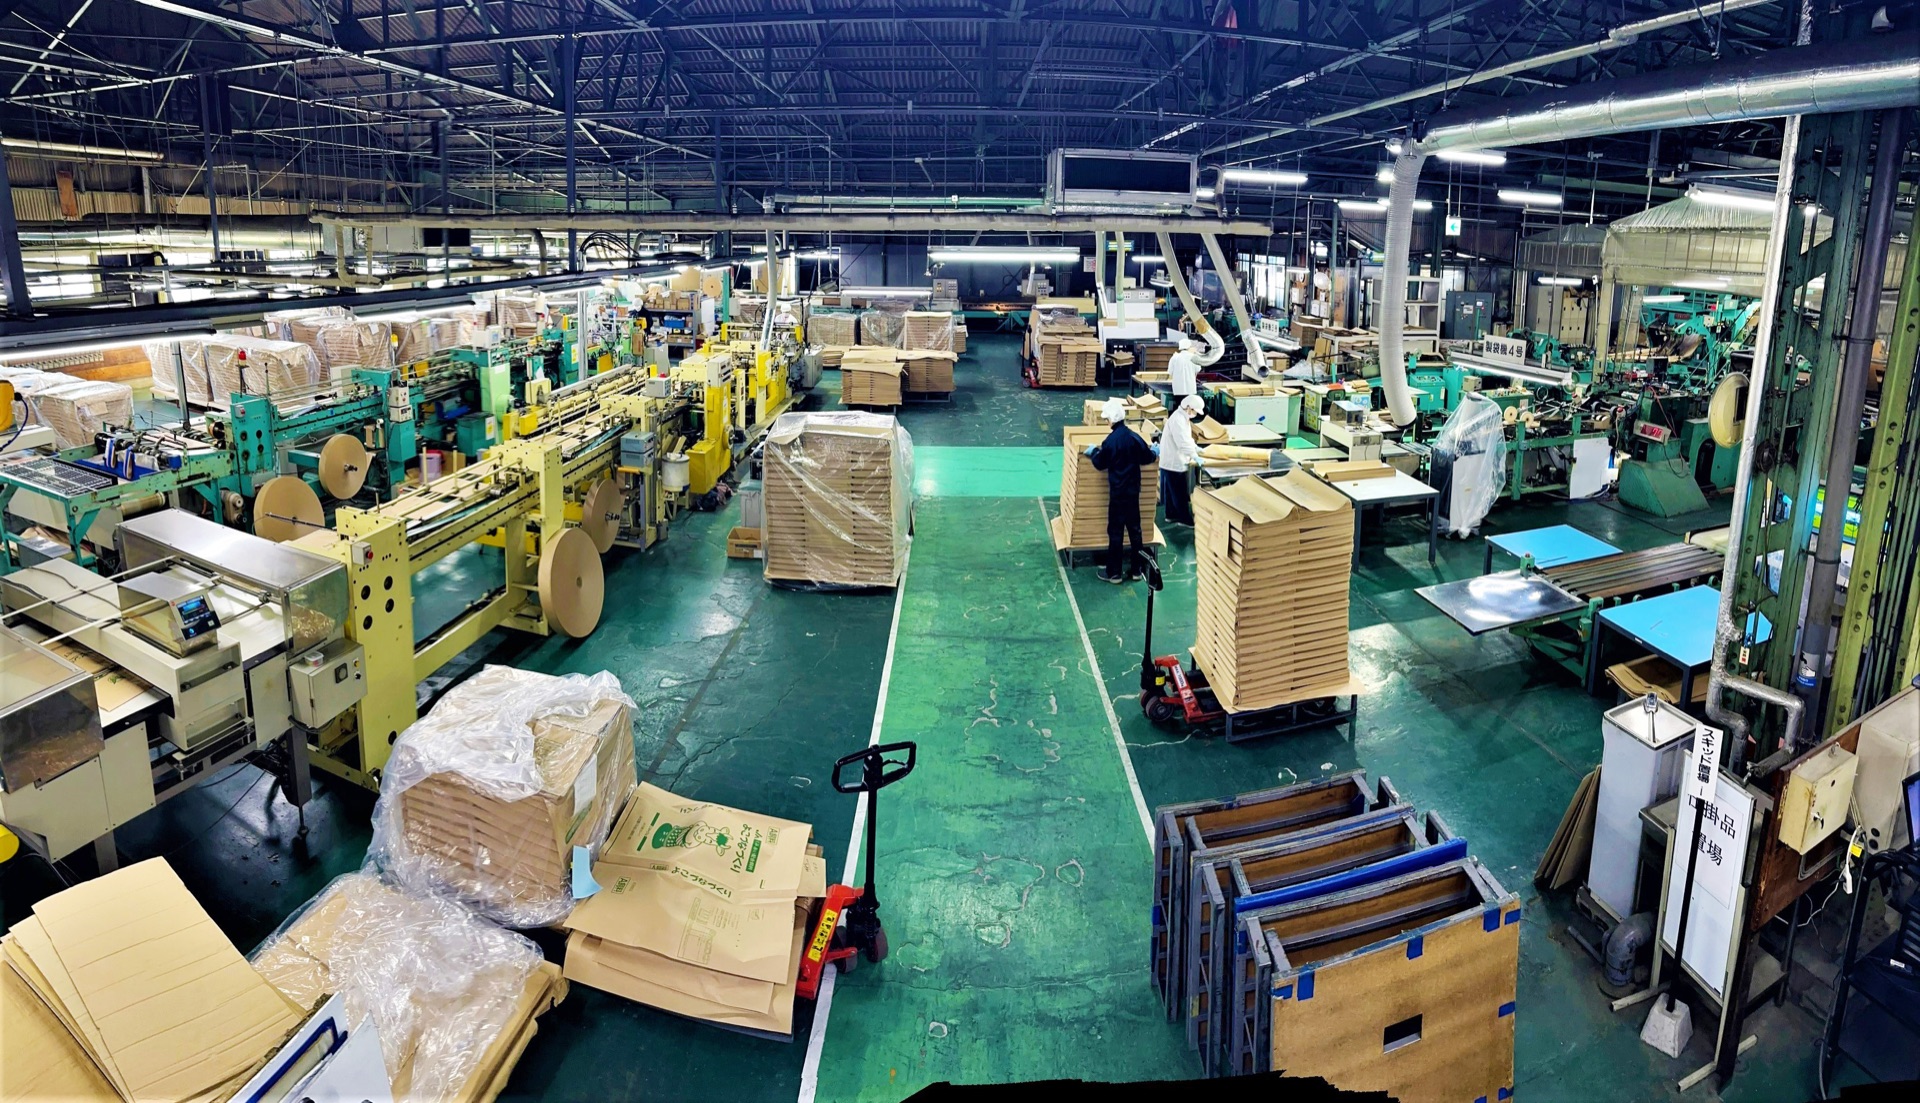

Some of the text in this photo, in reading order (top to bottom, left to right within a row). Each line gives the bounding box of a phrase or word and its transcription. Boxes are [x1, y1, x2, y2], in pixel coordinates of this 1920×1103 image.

[1697, 728, 1714, 784] スキッド置場
[730, 823, 752, 873] よこづなづくり
[671, 866, 732, 898] よこづなづくり
